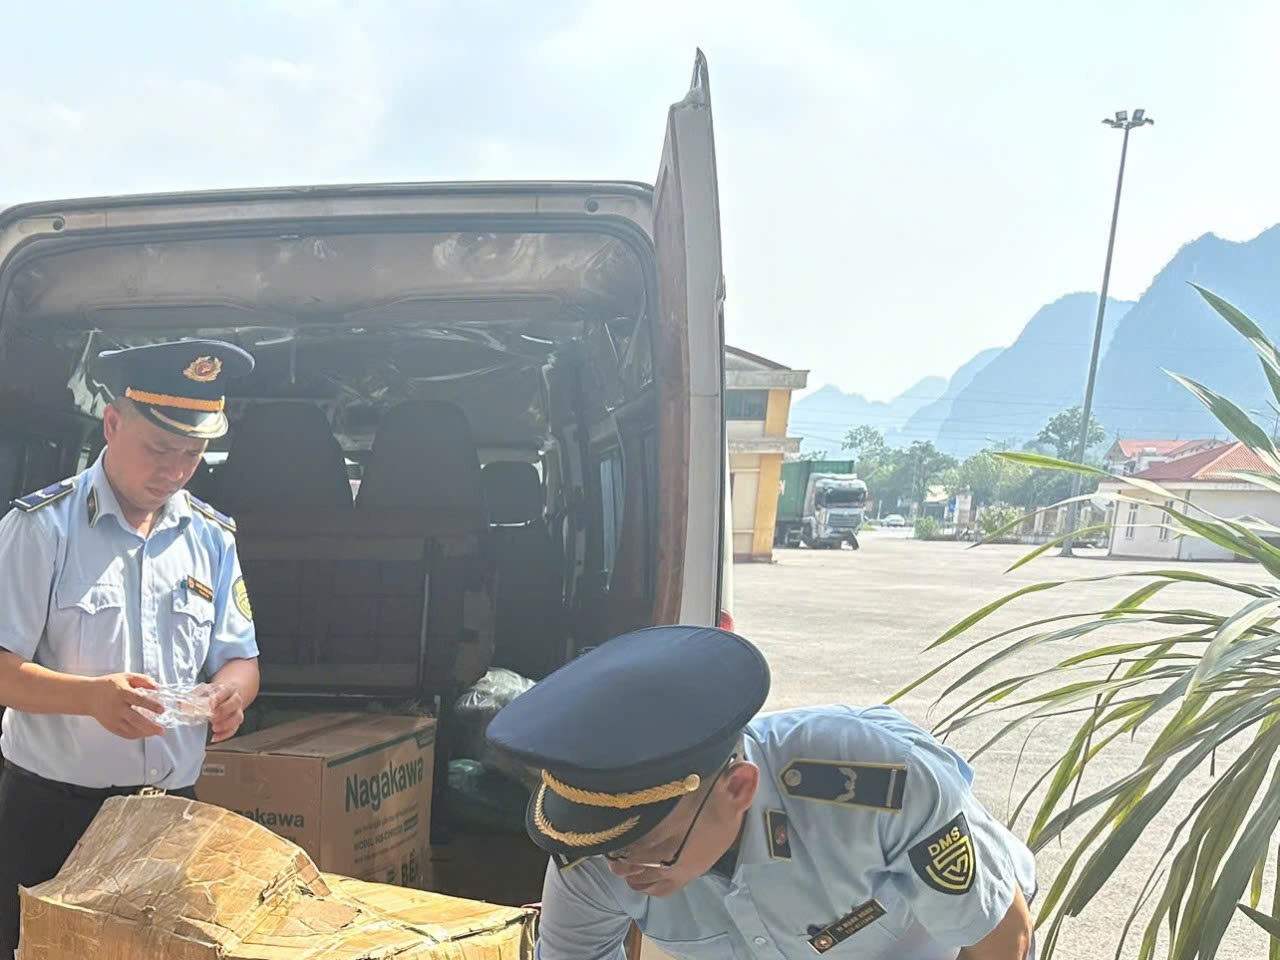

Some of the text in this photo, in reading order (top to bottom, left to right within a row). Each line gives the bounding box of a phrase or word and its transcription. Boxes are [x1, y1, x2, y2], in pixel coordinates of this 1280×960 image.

[344, 756, 424, 812] Nagakawa
[236, 808, 304, 828] akawa
[927, 826, 960, 856] DMS
